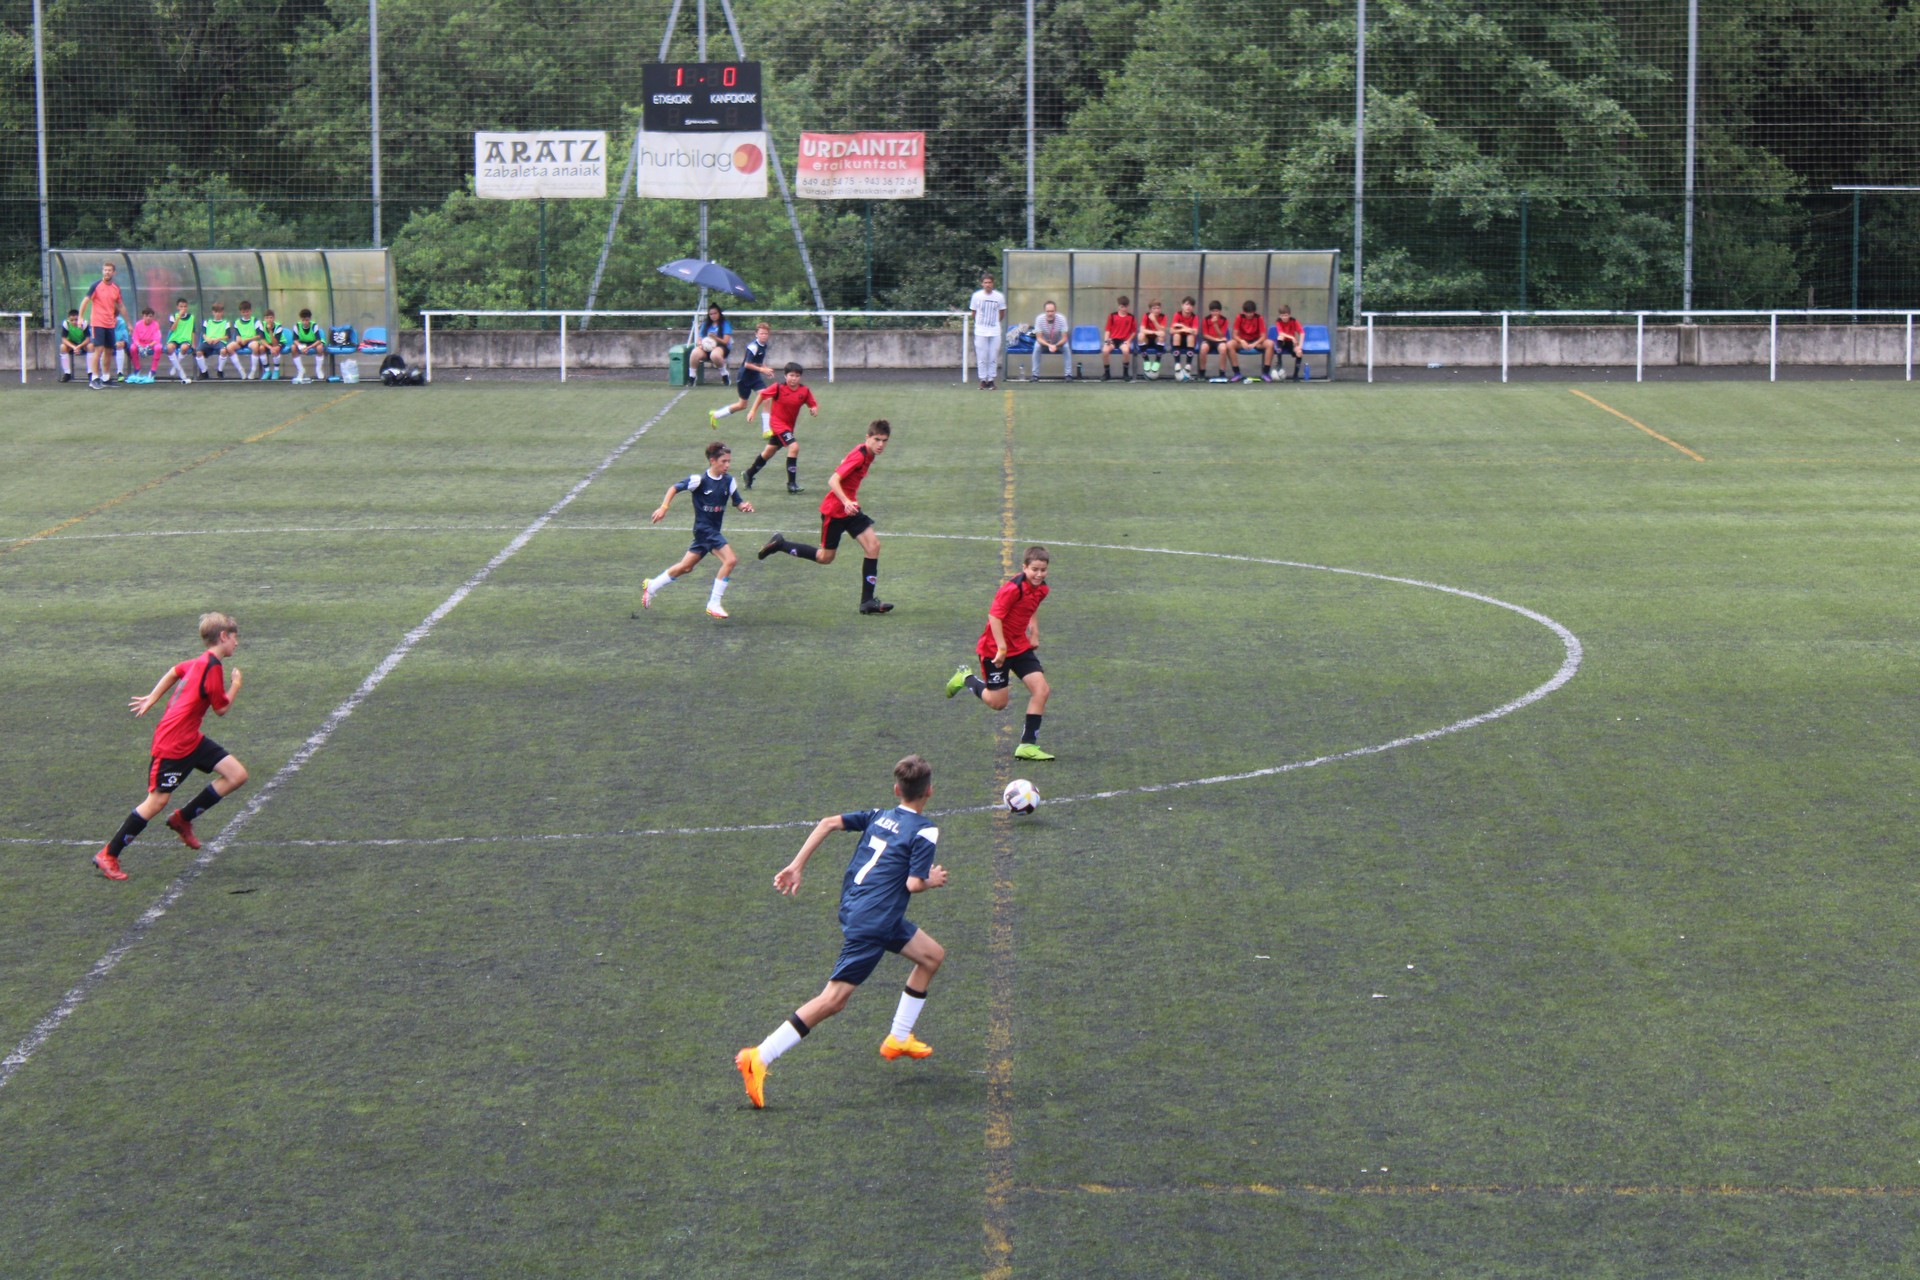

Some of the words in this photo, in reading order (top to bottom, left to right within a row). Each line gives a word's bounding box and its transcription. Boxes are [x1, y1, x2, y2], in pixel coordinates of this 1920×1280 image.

[676, 67, 683, 87] 1
[723, 67, 736, 86] 0
[653, 94, 692, 104] ETXEKOAK
[710, 94, 757, 103] KANPOKOAK
[484, 140, 600, 163] ARATZ
[803, 138, 918, 158] URDAINTZI
[484, 165, 548, 177] zabaleta
[552, 164, 600, 176] anaiak
[813, 159, 907, 171] eraikuntzak
[844, 177, 855, 186] 75
[865, 177, 880, 186] 943
[895, 177, 905, 186] 72
[854, 835, 887, 885] 7
